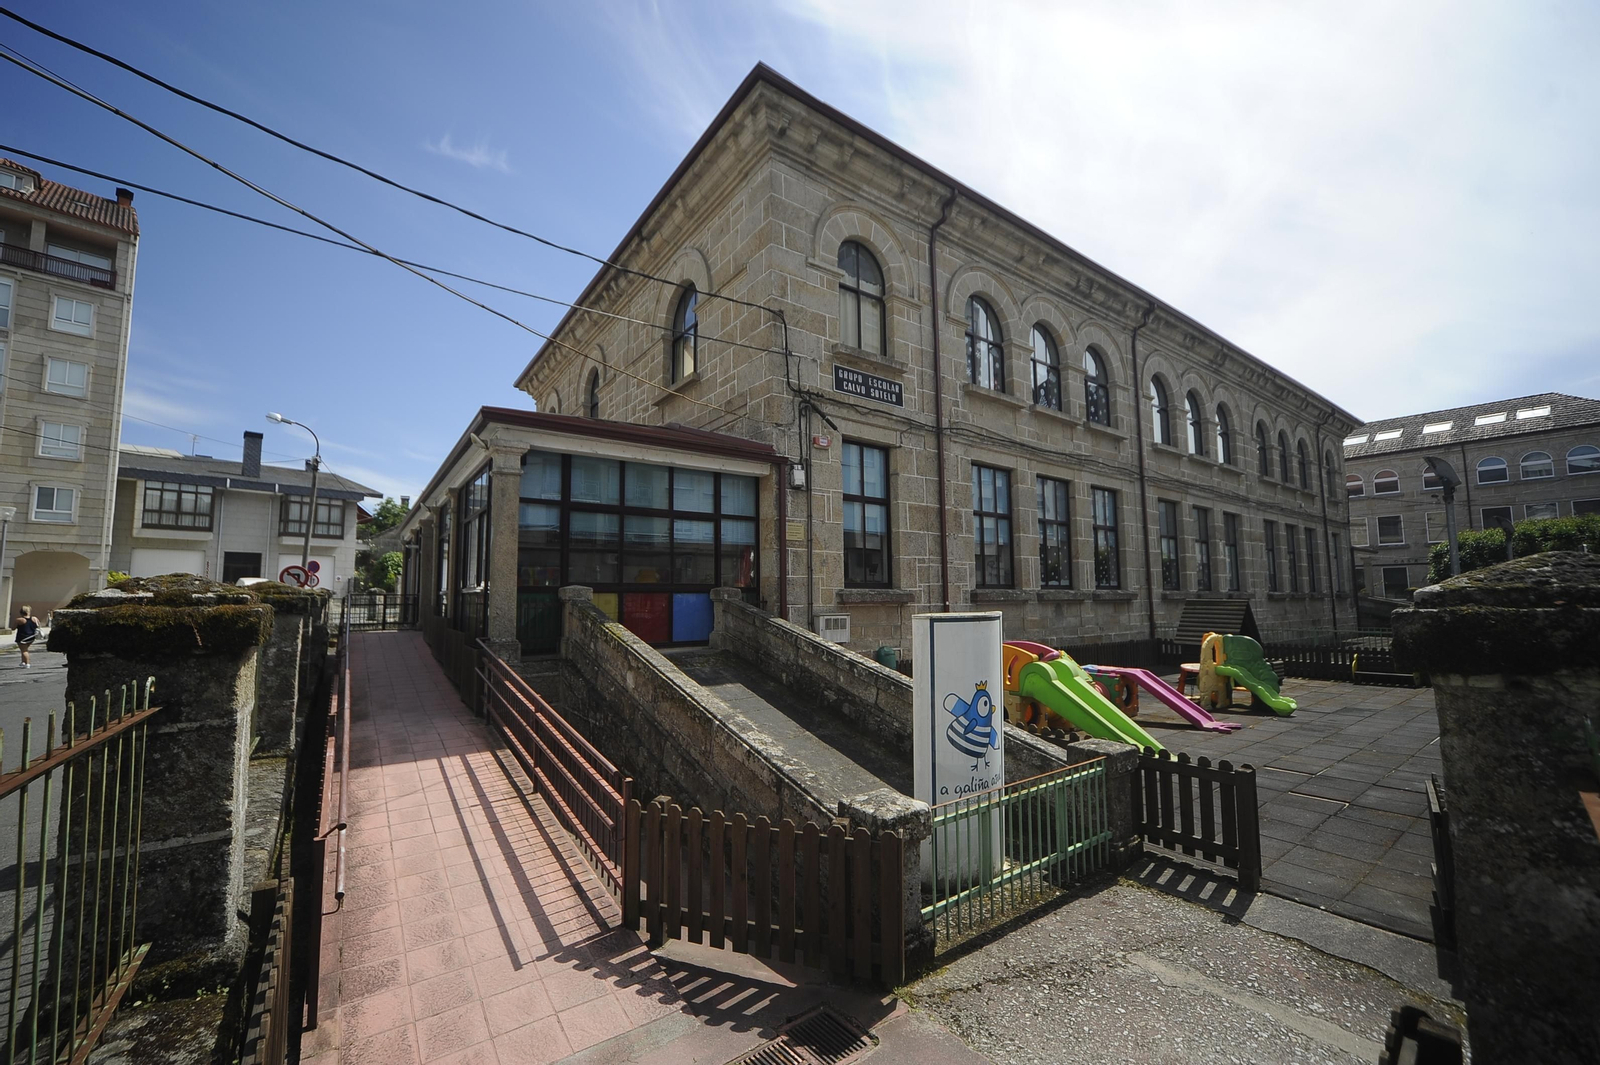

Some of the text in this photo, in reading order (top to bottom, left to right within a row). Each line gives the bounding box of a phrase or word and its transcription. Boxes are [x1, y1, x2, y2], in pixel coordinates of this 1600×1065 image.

[838, 369, 899, 393] GRUPO ESCOLAR
[843, 381, 896, 402] CALVO SOTELO
[940, 786, 949, 795] a
[954, 776, 989, 799] galiña
